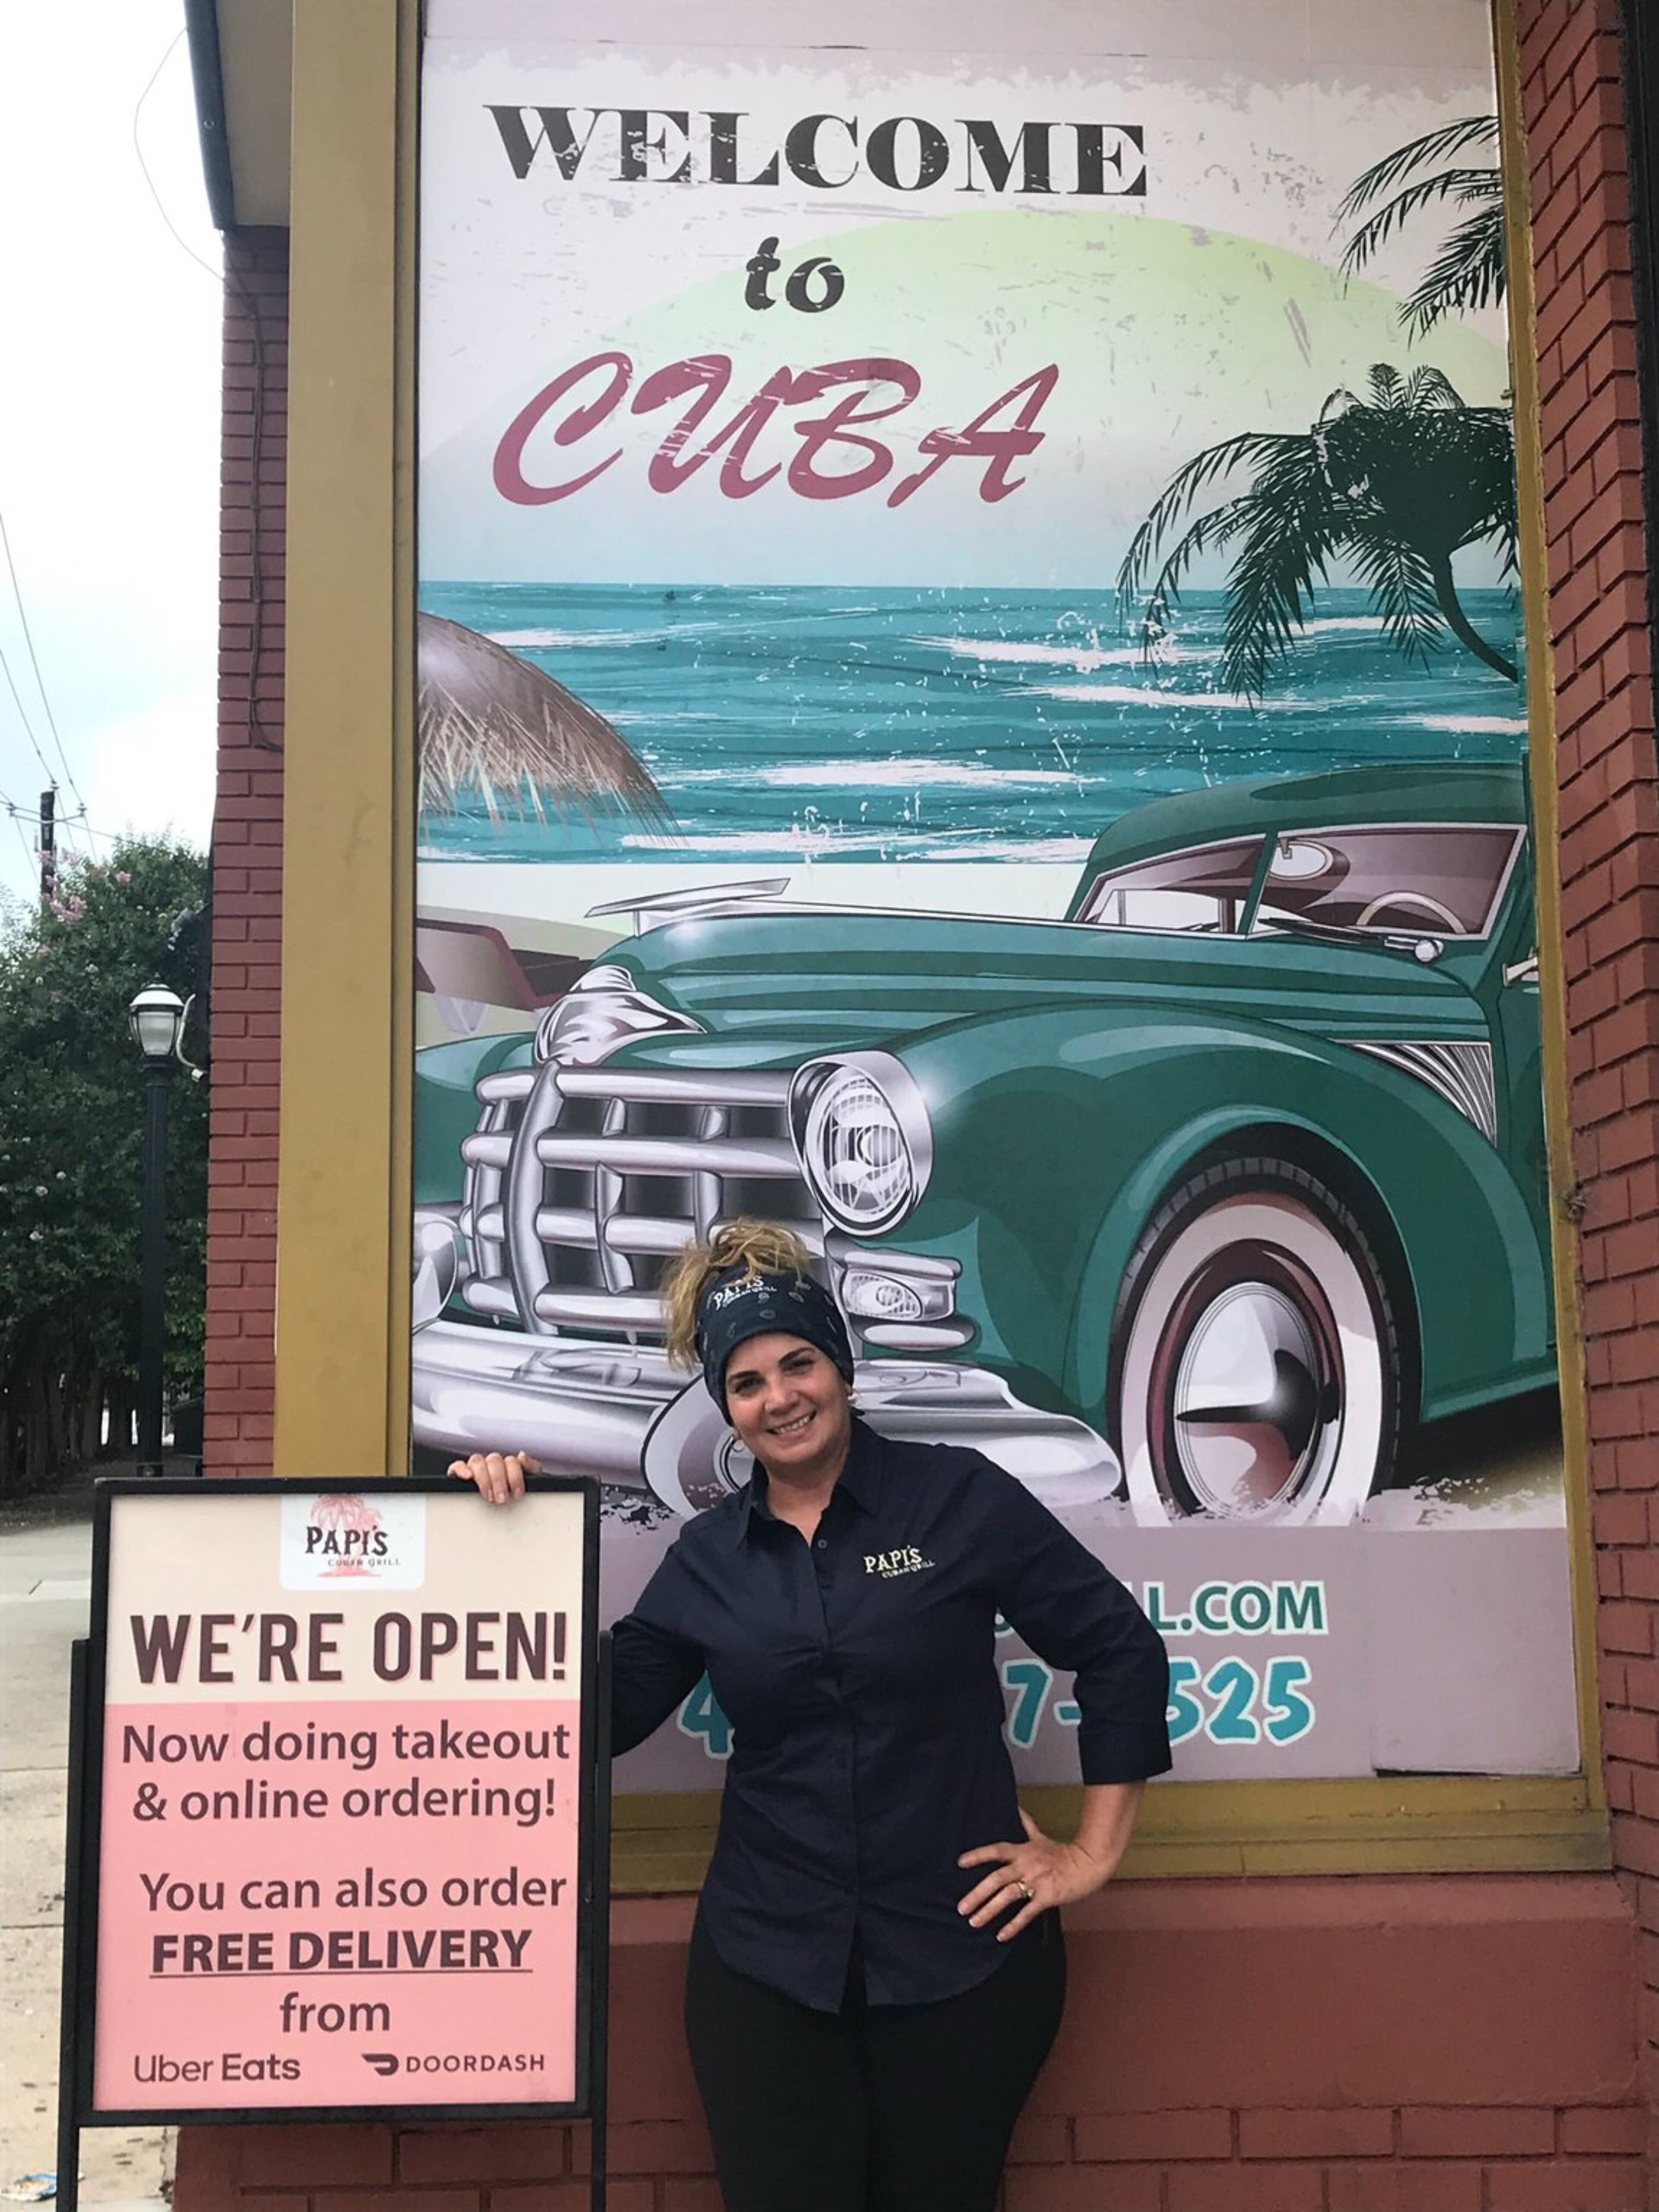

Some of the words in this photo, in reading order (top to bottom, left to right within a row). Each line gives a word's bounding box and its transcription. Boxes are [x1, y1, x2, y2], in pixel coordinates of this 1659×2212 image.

[483, 105, 1147, 197] WELCOME
[745, 237, 845, 313] to
[493, 351, 1059, 508] CUBA
[305, 1525, 388, 1556] PAPI'S
[368, 1557, 400, 1567] GRILL
[864, 1545, 922, 1573] PAPI'S
[1145, 1582, 1327, 1633] L.COM
[130, 1613, 343, 1684] WE'RE
[373, 1612, 566, 1681] OPEN!
[123, 1725, 229, 1763] Now
[242, 1721, 377, 1770] doing
[392, 1719, 570, 1760] takeout
[133, 1782, 167, 1821] &
[181, 1779, 328, 1821] online
[342, 1777, 554, 1827] ordering!
[140, 1873, 224, 1911] You
[240, 1880, 320, 1910] can
[335, 1867, 427, 1908] also
[442, 1866, 567, 1907] order
[153, 1932, 273, 1972] FREE
[289, 1929, 533, 1970] DELIVERY
[280, 1991, 390, 2033] from
[134, 2054, 214, 2083] Uber
[222, 2053, 301, 2081] Eats
[406, 2054, 544, 2073] DOORDASH
